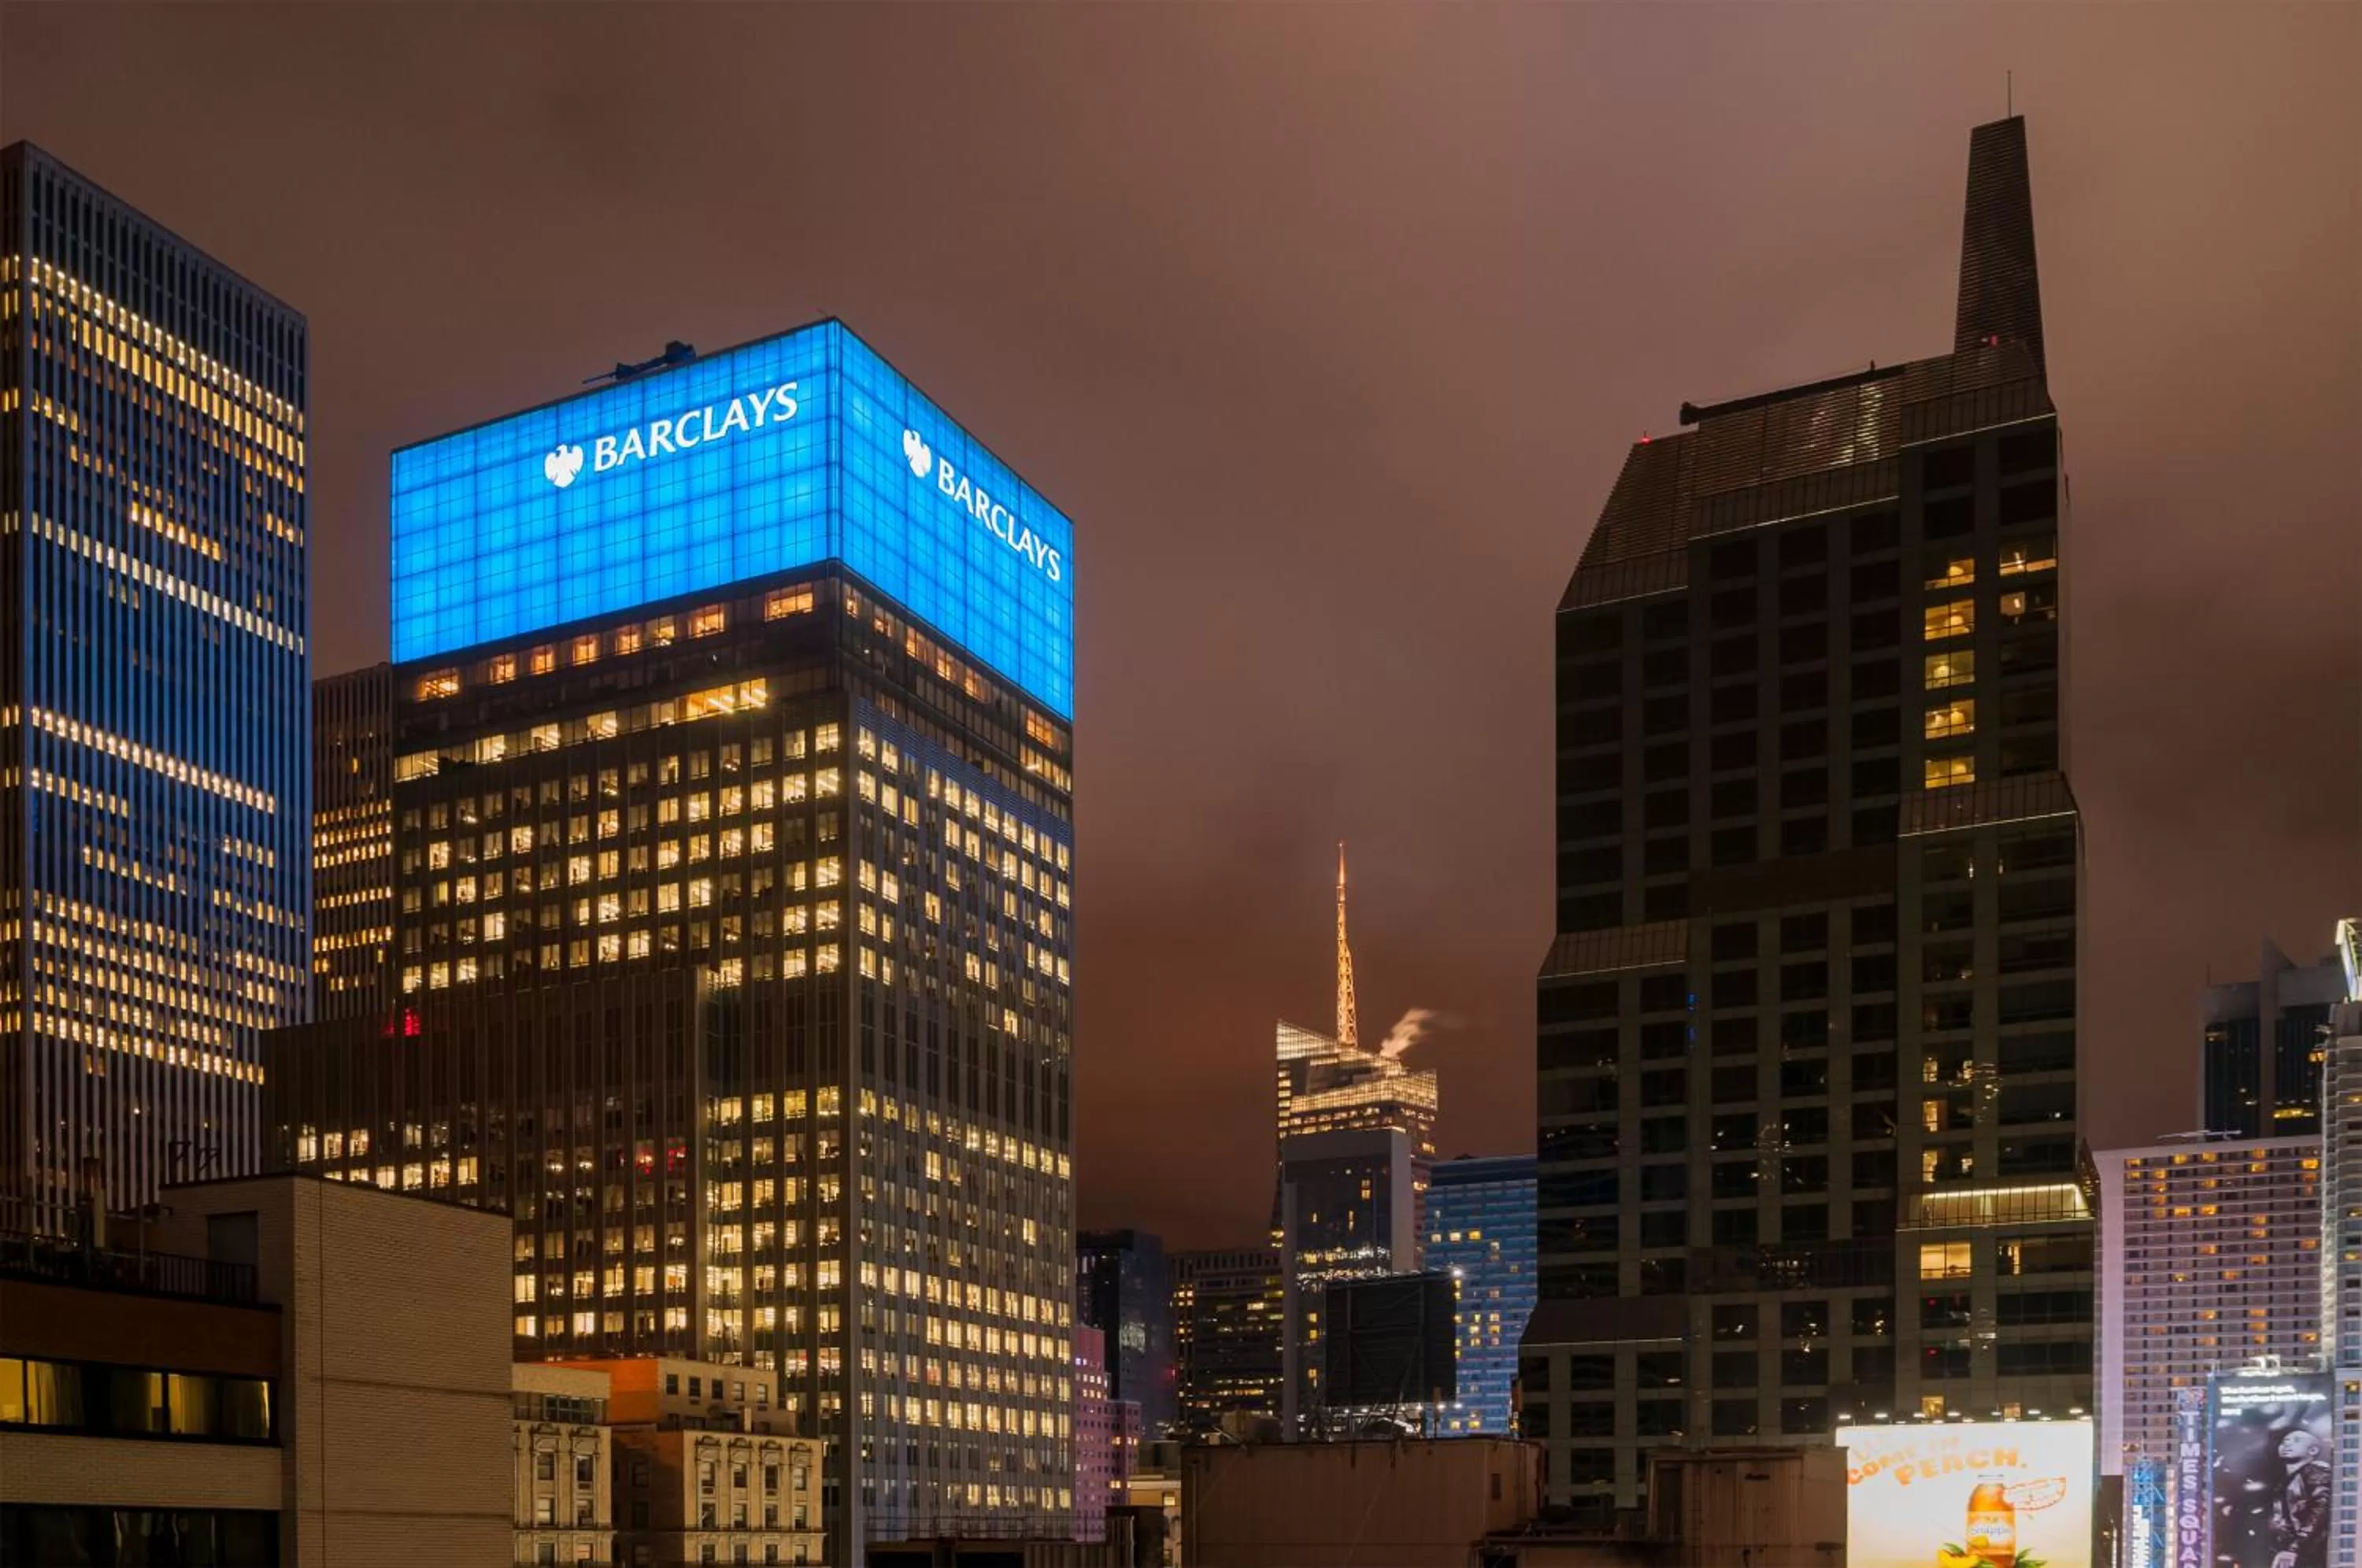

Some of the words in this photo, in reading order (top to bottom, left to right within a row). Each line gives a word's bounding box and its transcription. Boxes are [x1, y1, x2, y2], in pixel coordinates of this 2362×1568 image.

[593, 382, 798, 472] BARCLAYS
[938, 457, 1061, 582] BARCLAYS
[2179, 1411, 2200, 1488] TIMES
